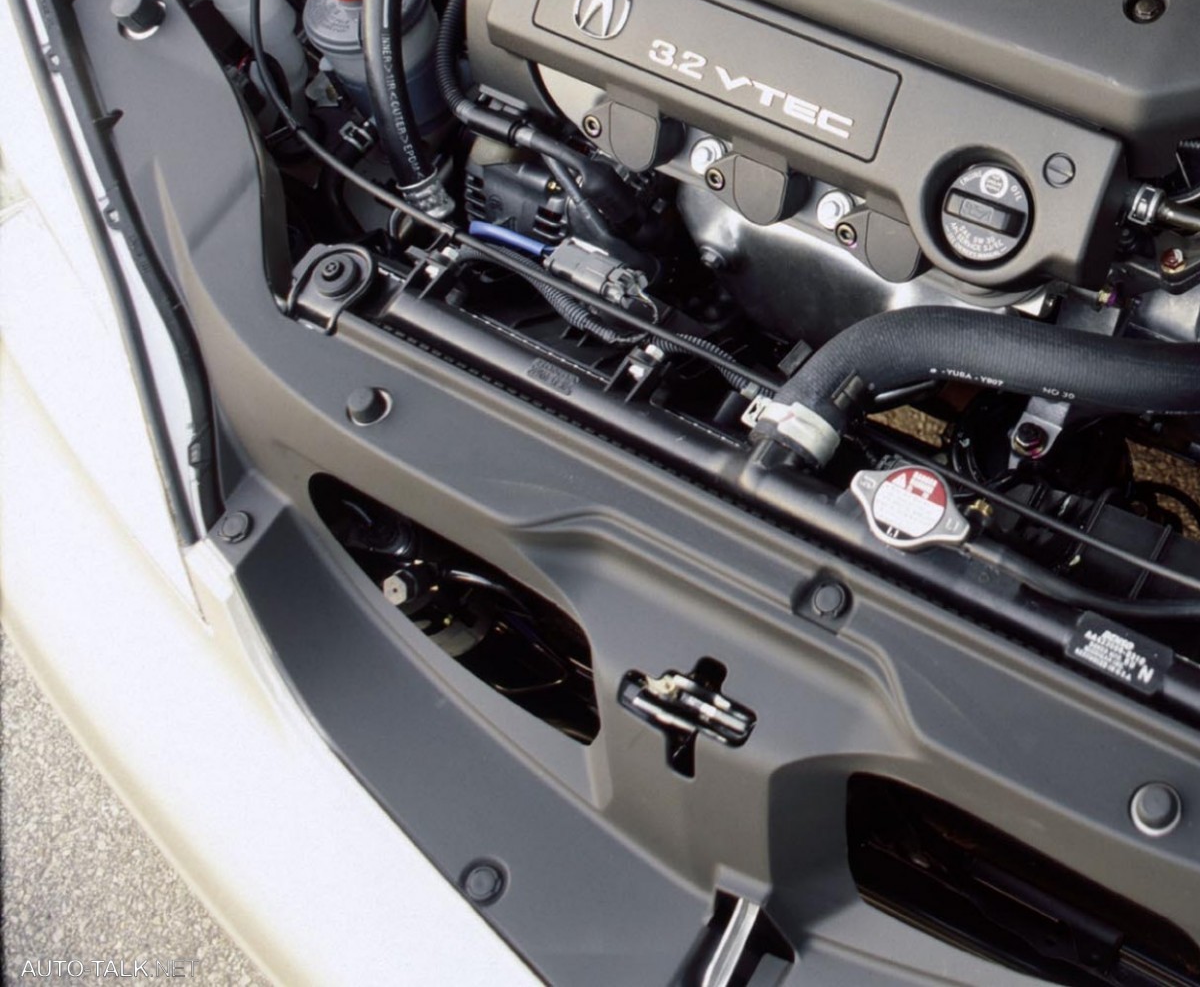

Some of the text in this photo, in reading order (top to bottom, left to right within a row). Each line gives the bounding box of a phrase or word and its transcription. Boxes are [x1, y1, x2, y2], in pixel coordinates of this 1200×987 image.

[648, 39, 854, 139] 3.2 VTEC
[1010, 185, 1023, 202] OIL
[1137, 664, 1154, 684] N
